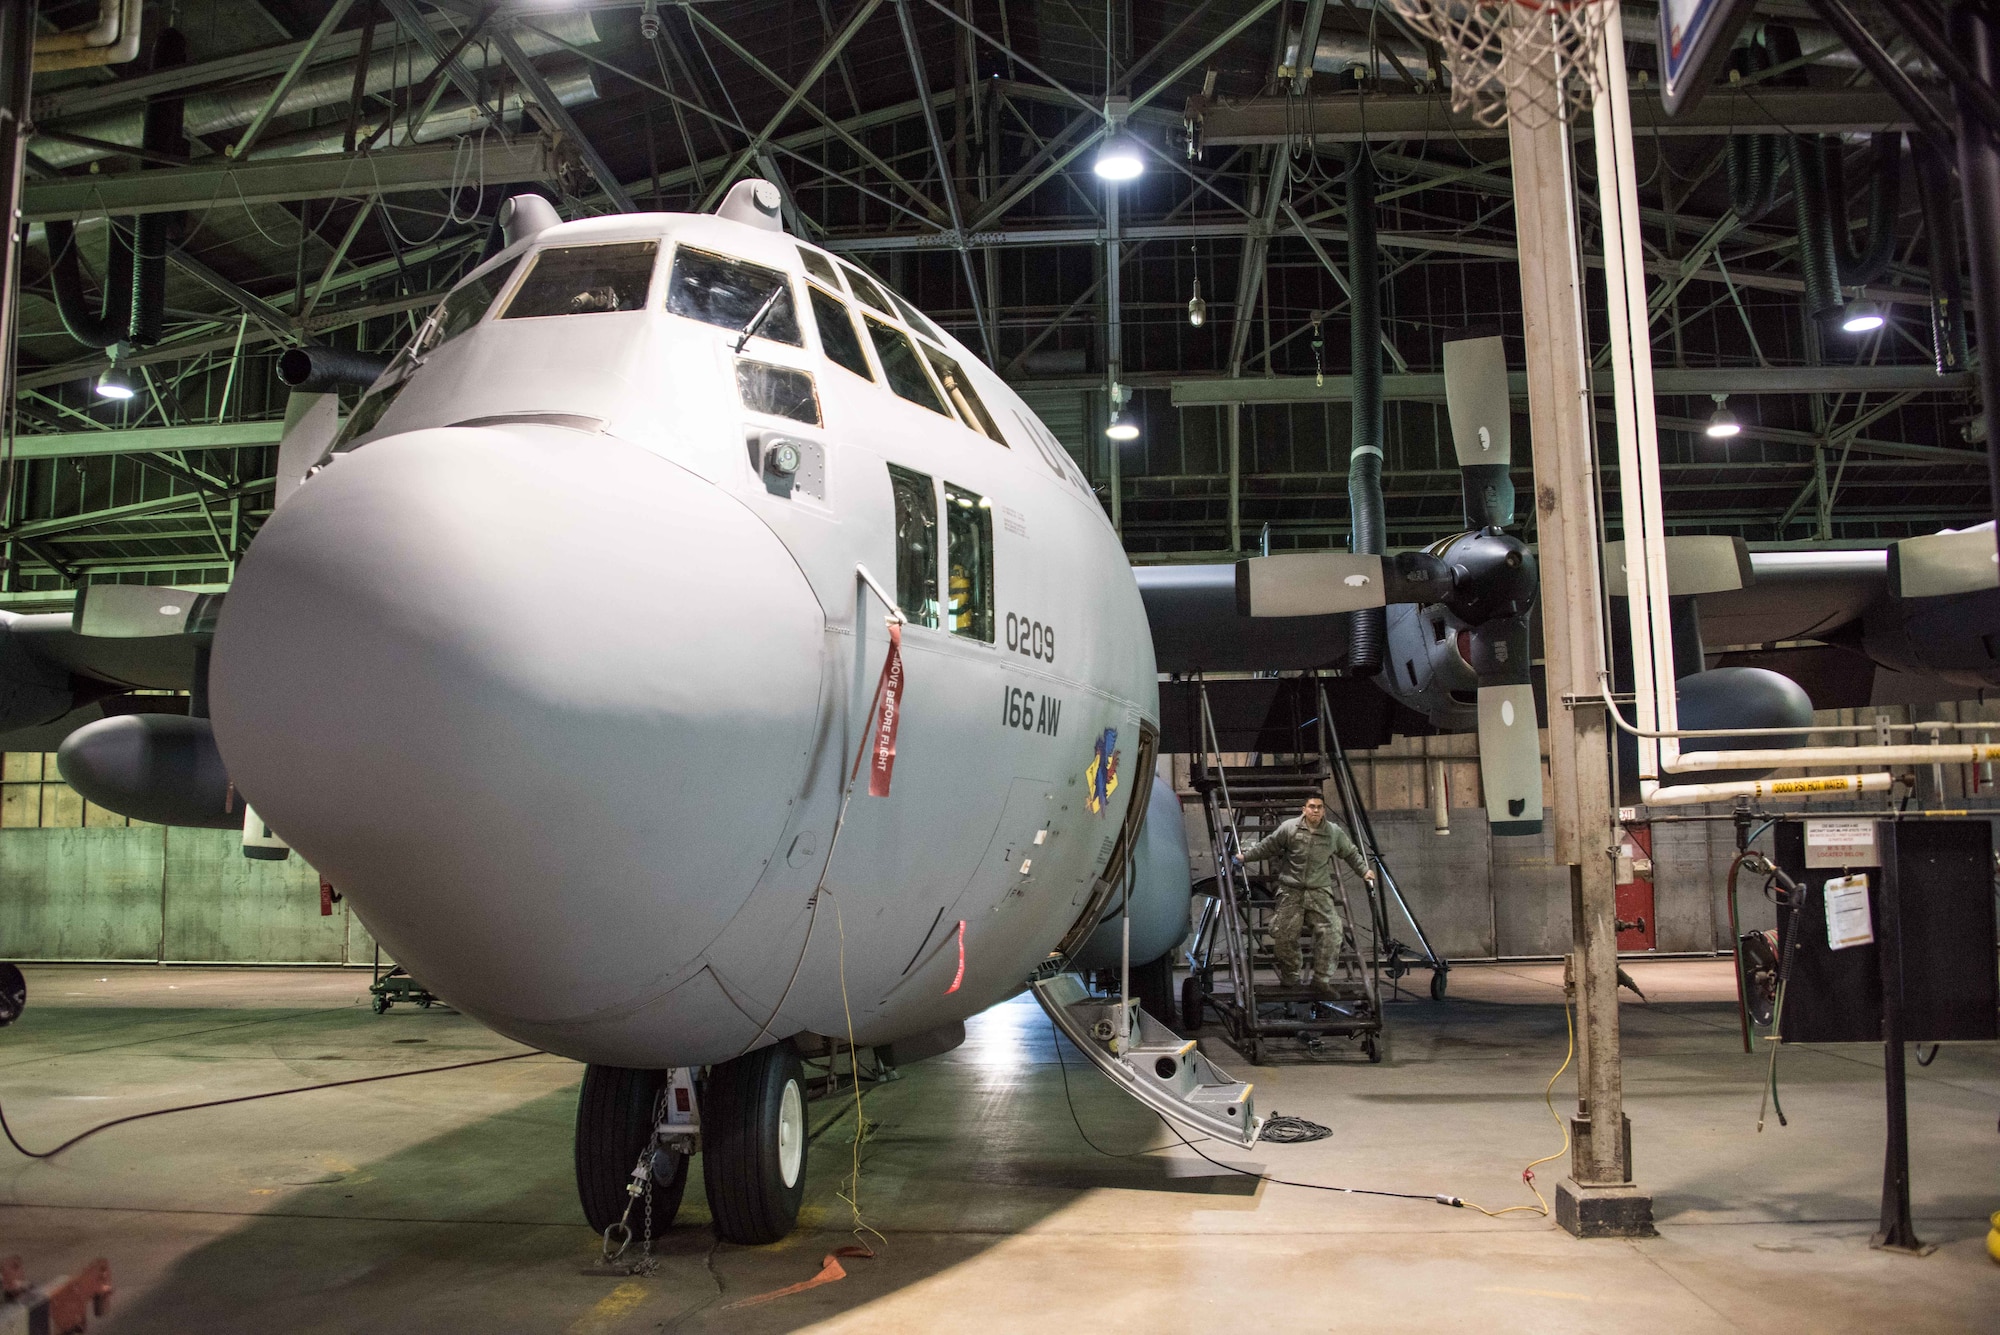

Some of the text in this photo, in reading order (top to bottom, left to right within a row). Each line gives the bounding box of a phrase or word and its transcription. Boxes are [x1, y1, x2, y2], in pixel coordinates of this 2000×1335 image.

[1006, 611, 1055, 663] 0209
[877, 650, 901, 772] MOVE BEFORE FLIGHT
[1002, 685, 1062, 737] 166 AW
[1773, 778, 1846, 794] 3000 PSI HOT WATER
